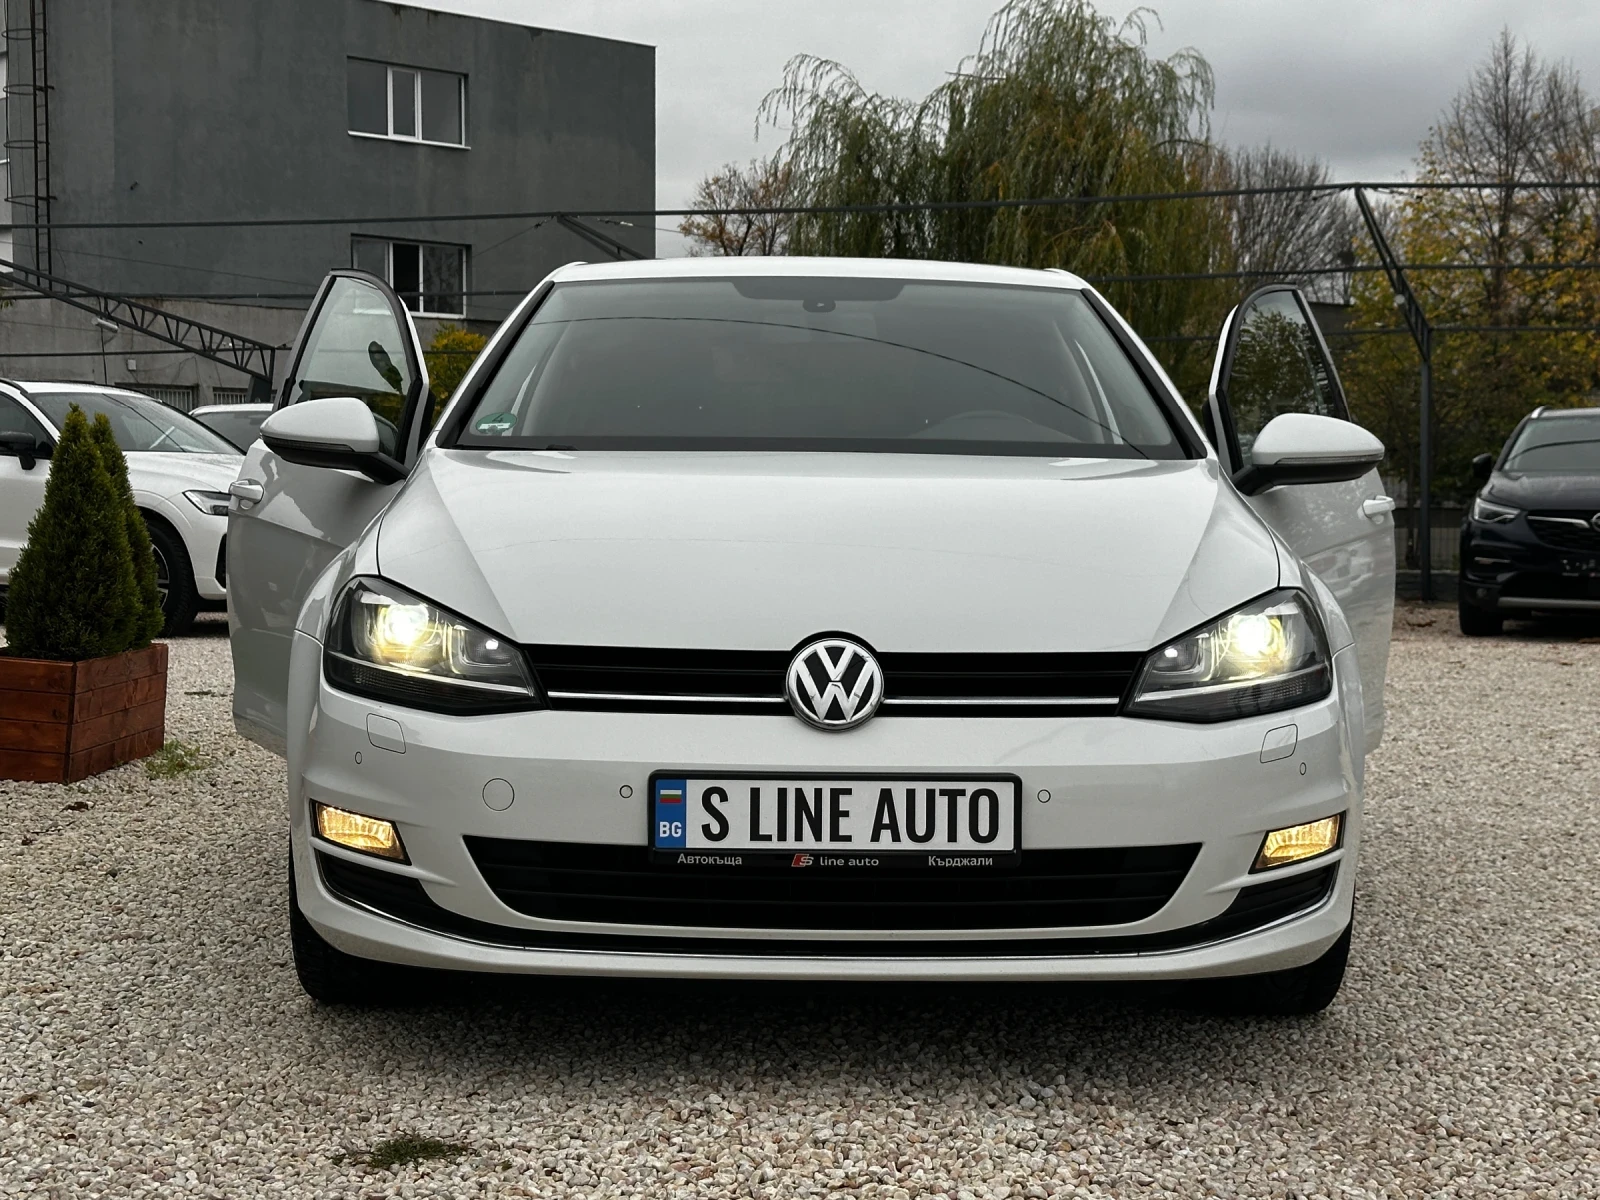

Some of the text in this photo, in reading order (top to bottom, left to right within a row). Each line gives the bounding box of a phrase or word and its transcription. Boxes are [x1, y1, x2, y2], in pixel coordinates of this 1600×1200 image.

[789, 639, 881, 727] VW
[701, 786, 1000, 844] S LINE AUTO
[659, 821, 682, 838] BG
[677, 853, 742, 866] Автокъща
[820, 856, 845, 866] line
[848, 857, 880, 866] auto
[928, 855, 993, 867] Кърджали
